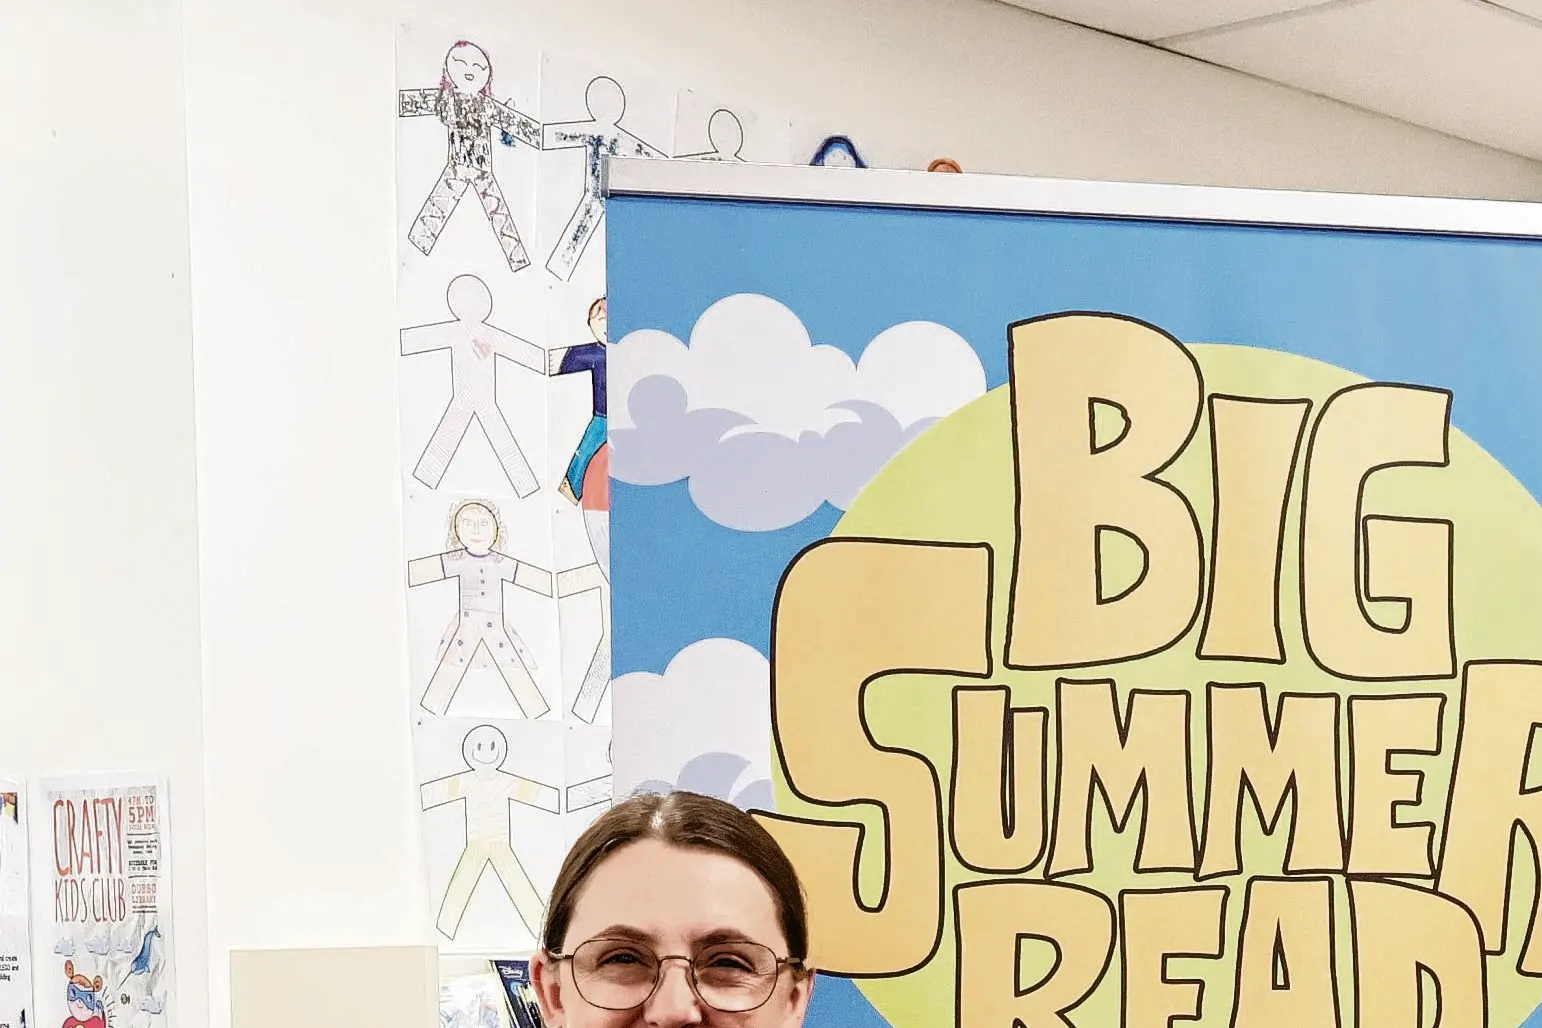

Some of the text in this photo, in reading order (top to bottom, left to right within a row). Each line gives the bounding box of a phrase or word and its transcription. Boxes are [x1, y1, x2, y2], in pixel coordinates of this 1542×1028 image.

[1005, 310, 1457, 681] BIG
[53, 796, 123, 876] CRAFTY
[128, 805, 155, 823] 5PM
[54, 877, 127, 924] KIDS CLUB
